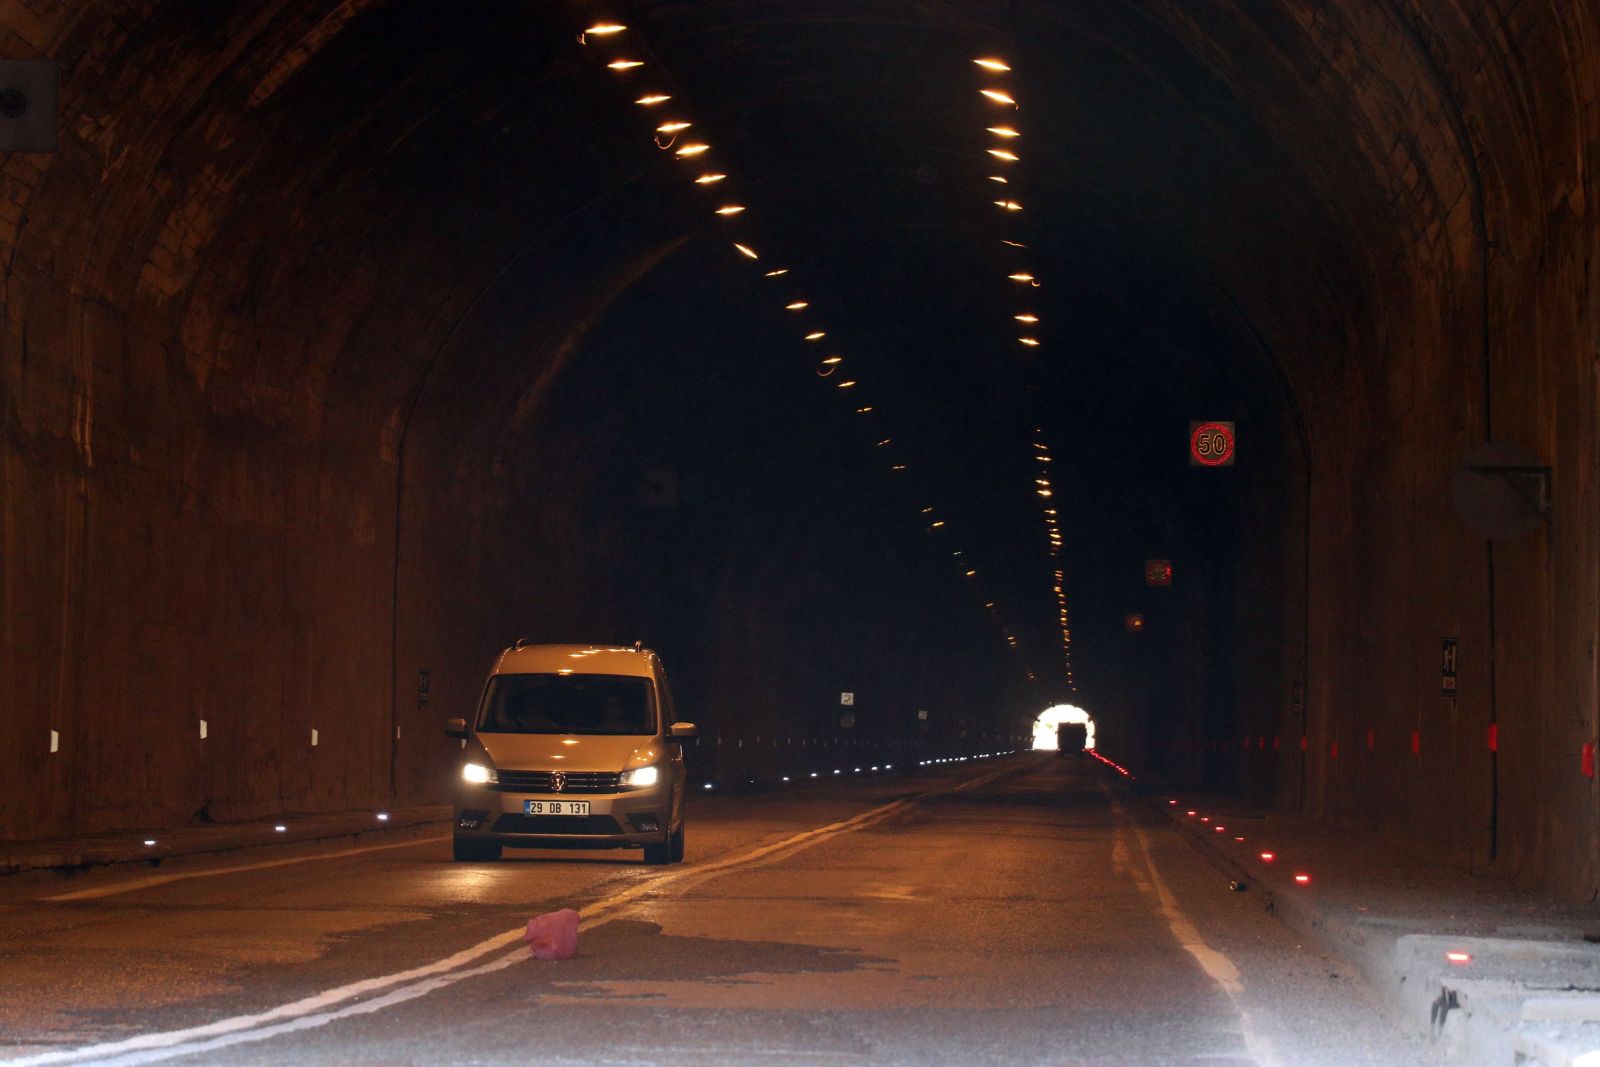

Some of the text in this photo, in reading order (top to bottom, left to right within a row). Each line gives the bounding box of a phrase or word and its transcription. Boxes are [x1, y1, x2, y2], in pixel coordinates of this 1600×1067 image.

[1199, 434, 1226, 455] 50
[531, 803, 586, 814] 29 DB 131
